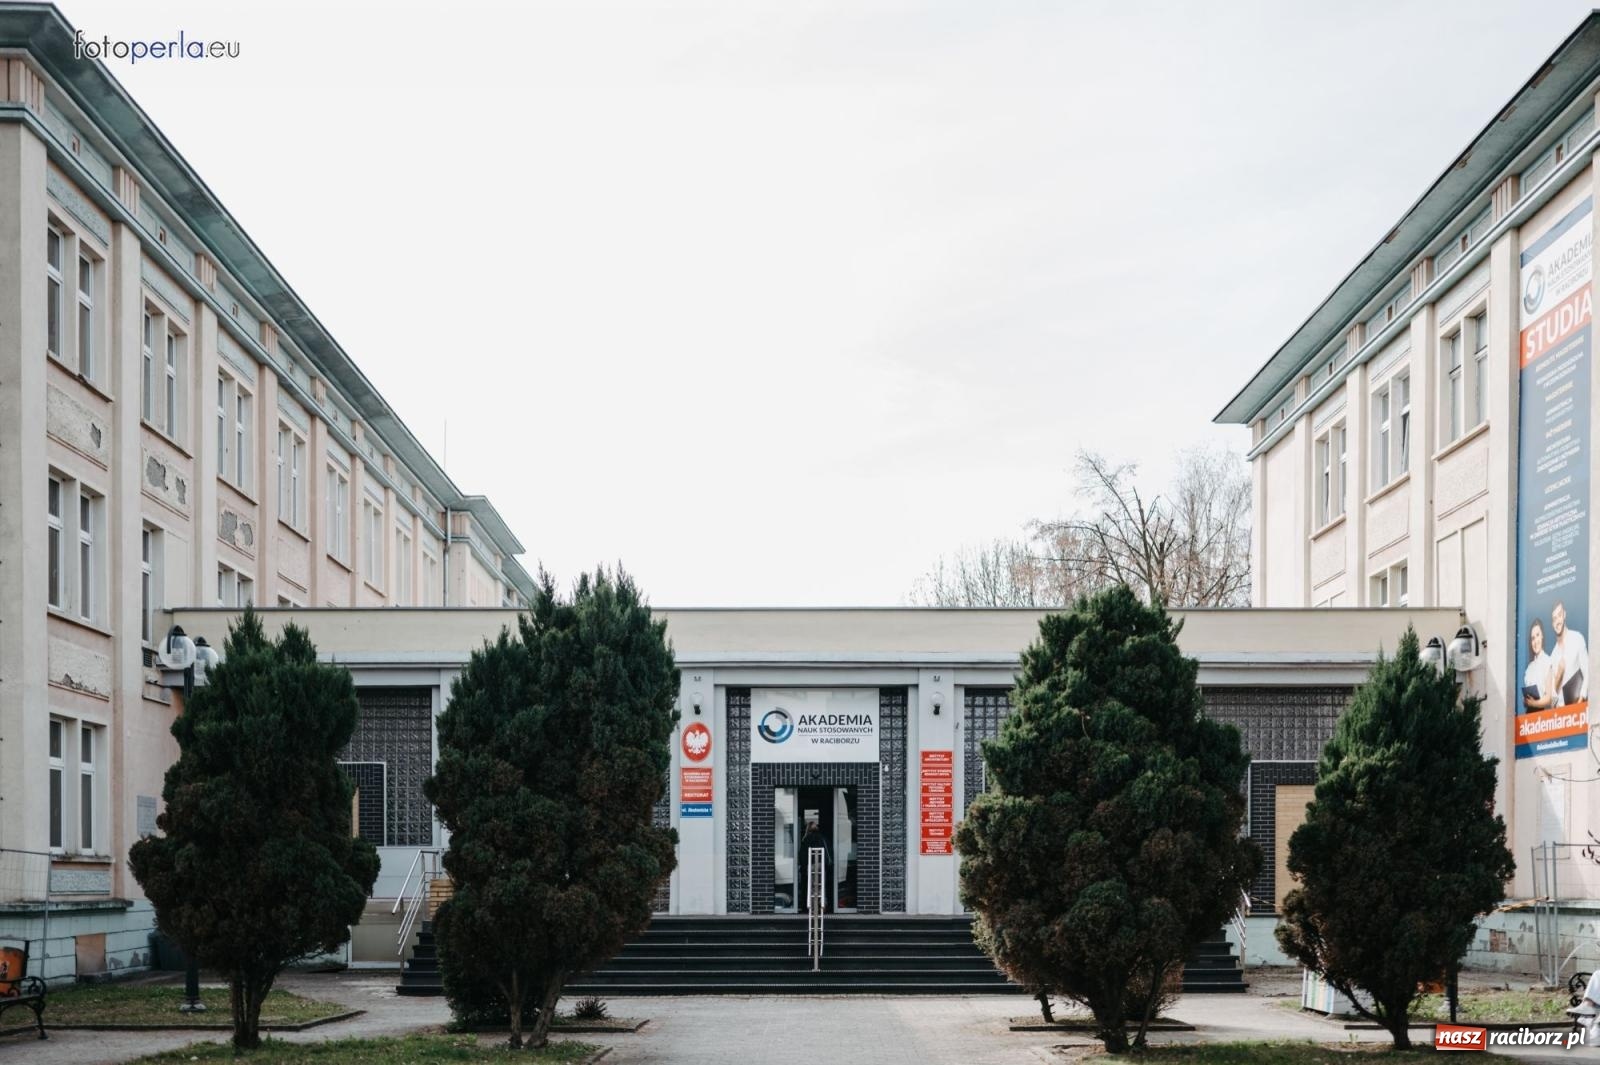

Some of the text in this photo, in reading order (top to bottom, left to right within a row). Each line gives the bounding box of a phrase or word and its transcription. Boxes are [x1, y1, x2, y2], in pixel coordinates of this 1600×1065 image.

[1526, 288, 1592, 359] STUDIA
[798, 714, 872, 726] AKADEMIA
[1519, 706, 1589, 736] akademiarac.pl
